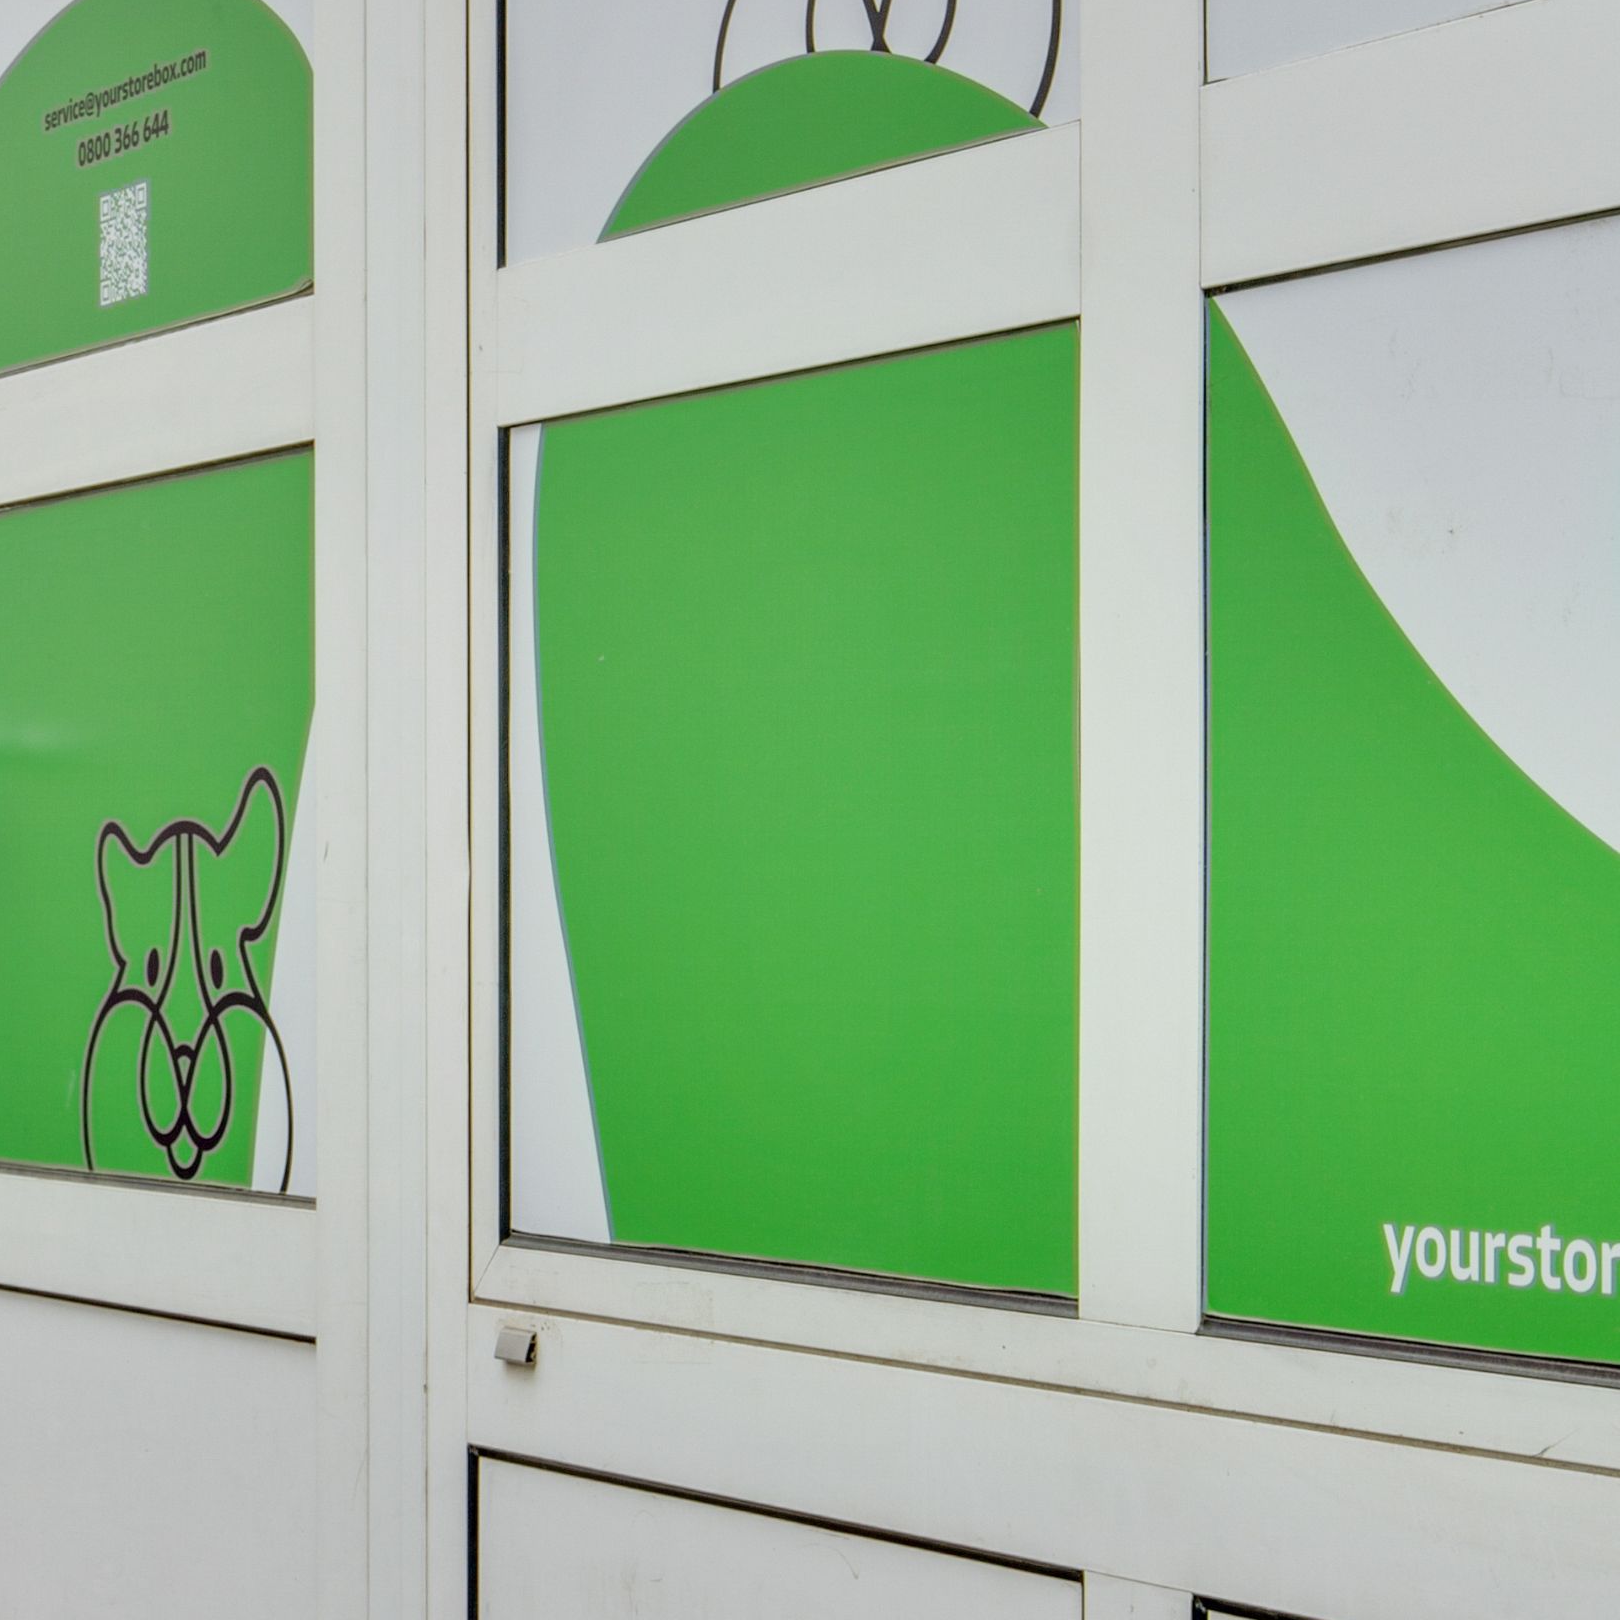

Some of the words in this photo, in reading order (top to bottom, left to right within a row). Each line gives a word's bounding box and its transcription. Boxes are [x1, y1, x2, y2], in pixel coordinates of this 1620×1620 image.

[44, 50, 207, 131] service@yourstorebox.com
[78, 132, 111, 167] 0800
[114, 121, 140, 154] 366
[143, 109, 170, 143] 644
[1383, 1222, 1620, 1296] yourstor
